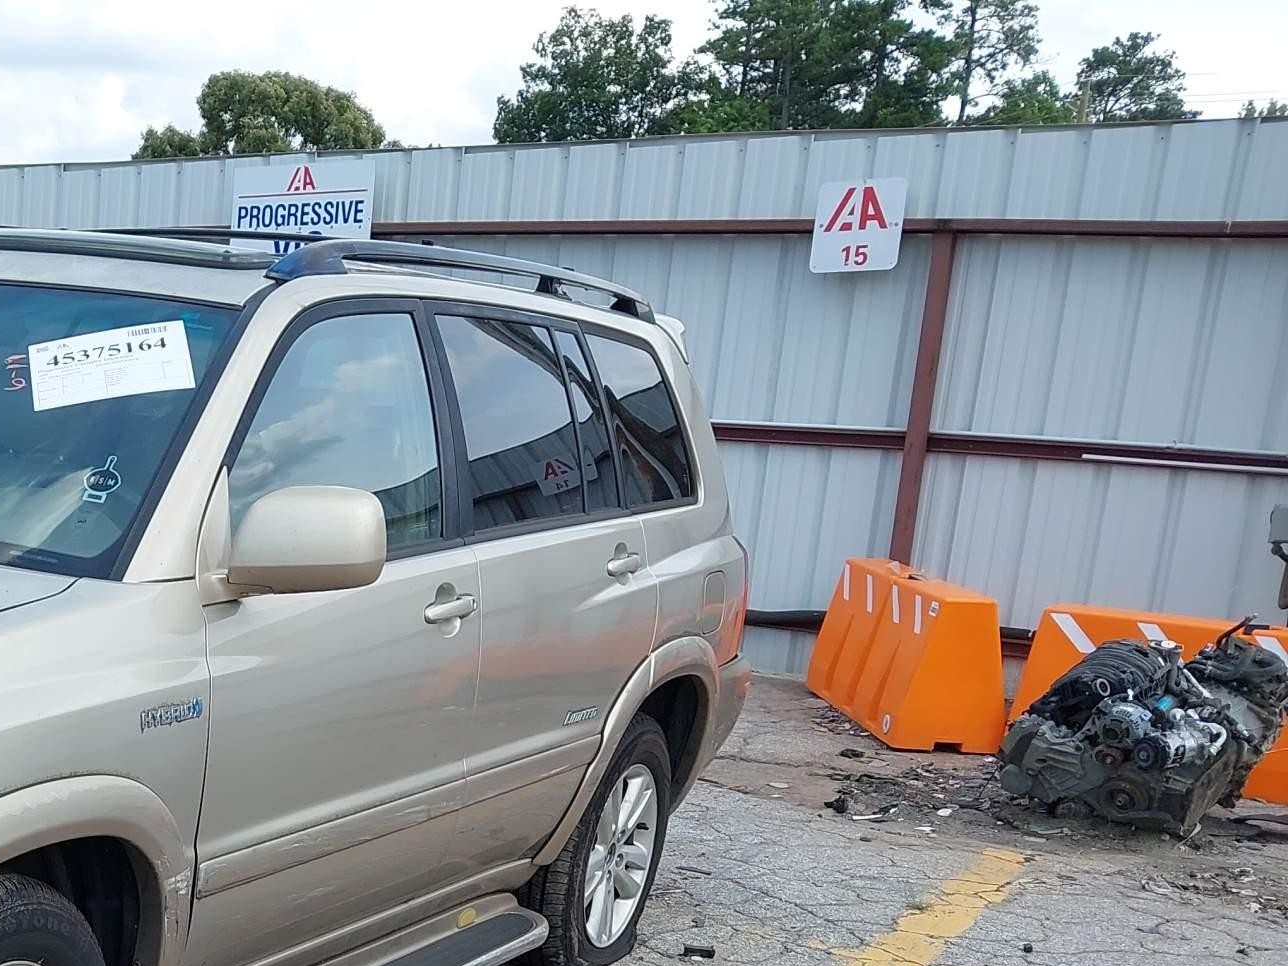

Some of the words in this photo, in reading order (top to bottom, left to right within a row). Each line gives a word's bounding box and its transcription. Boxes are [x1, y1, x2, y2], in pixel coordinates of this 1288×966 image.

[237, 200, 365, 229] PROGRESSIVE
[841, 244, 869, 267] 15
[46, 336, 168, 367] 45375164
